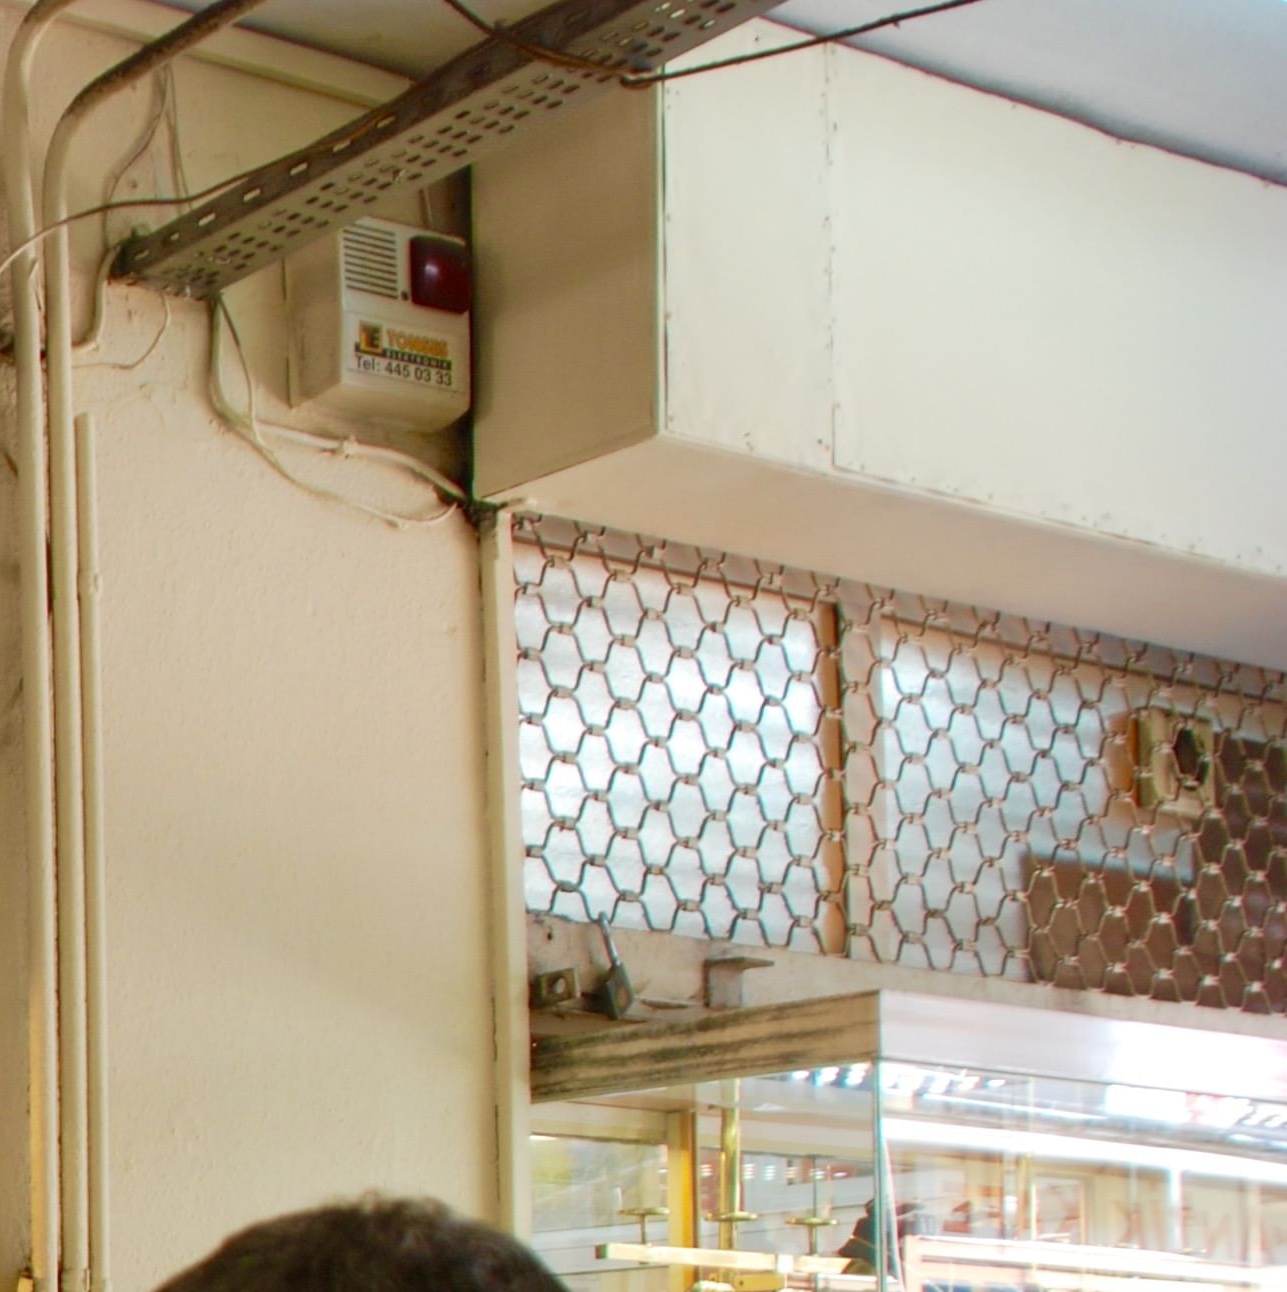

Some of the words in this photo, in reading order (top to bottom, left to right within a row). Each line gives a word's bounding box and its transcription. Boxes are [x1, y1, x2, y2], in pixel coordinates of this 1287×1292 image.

[355, 354, 380, 372] Tel:
[385, 360, 410, 378] 445
[414, 366, 432, 383] 03
[435, 370, 452, 386] 33
